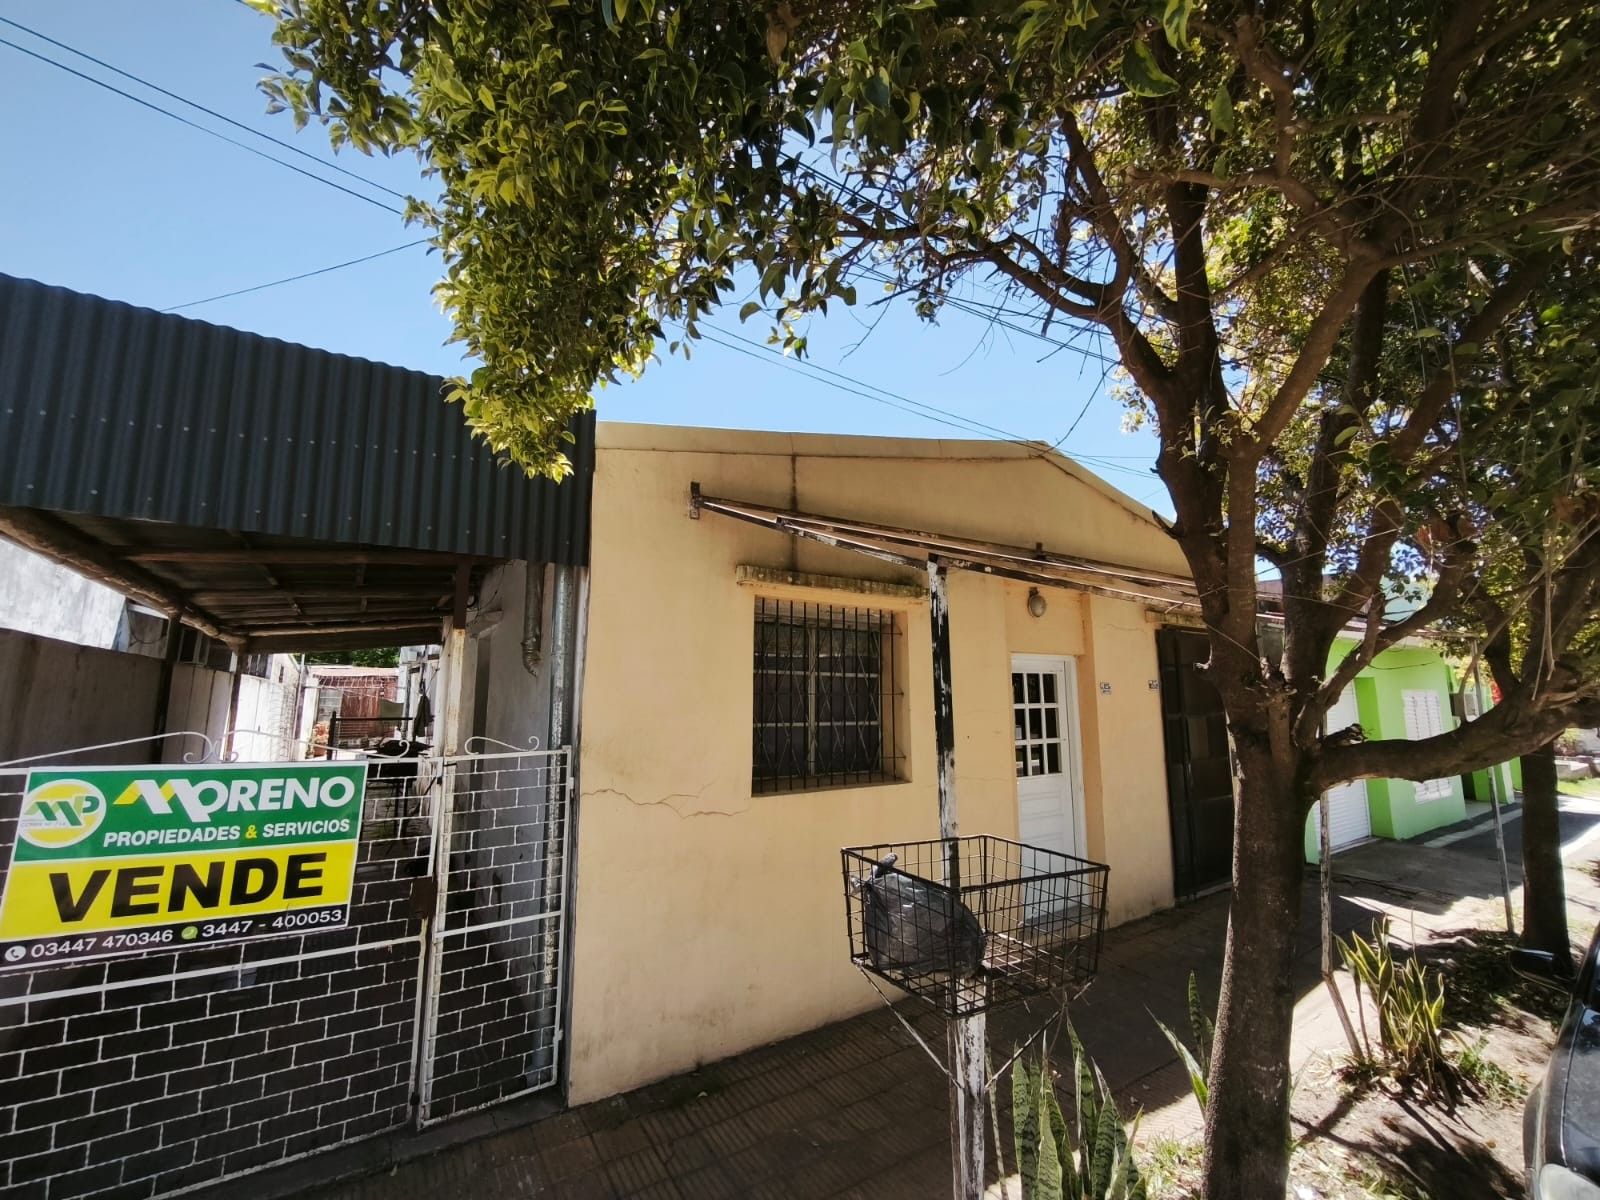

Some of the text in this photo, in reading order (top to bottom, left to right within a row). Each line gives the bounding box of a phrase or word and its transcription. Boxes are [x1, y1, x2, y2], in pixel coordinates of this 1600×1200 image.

[113, 776, 355, 822] MORENO
[103, 819, 350, 847] PROPIEDADES & SERVICIOS
[49, 852, 327, 923] VENDE
[31, 938, 96, 959] 03447
[102, 929, 173, 949] 470346
[202, 921, 253, 938] 3447
[272, 909, 342, 930] 400053
